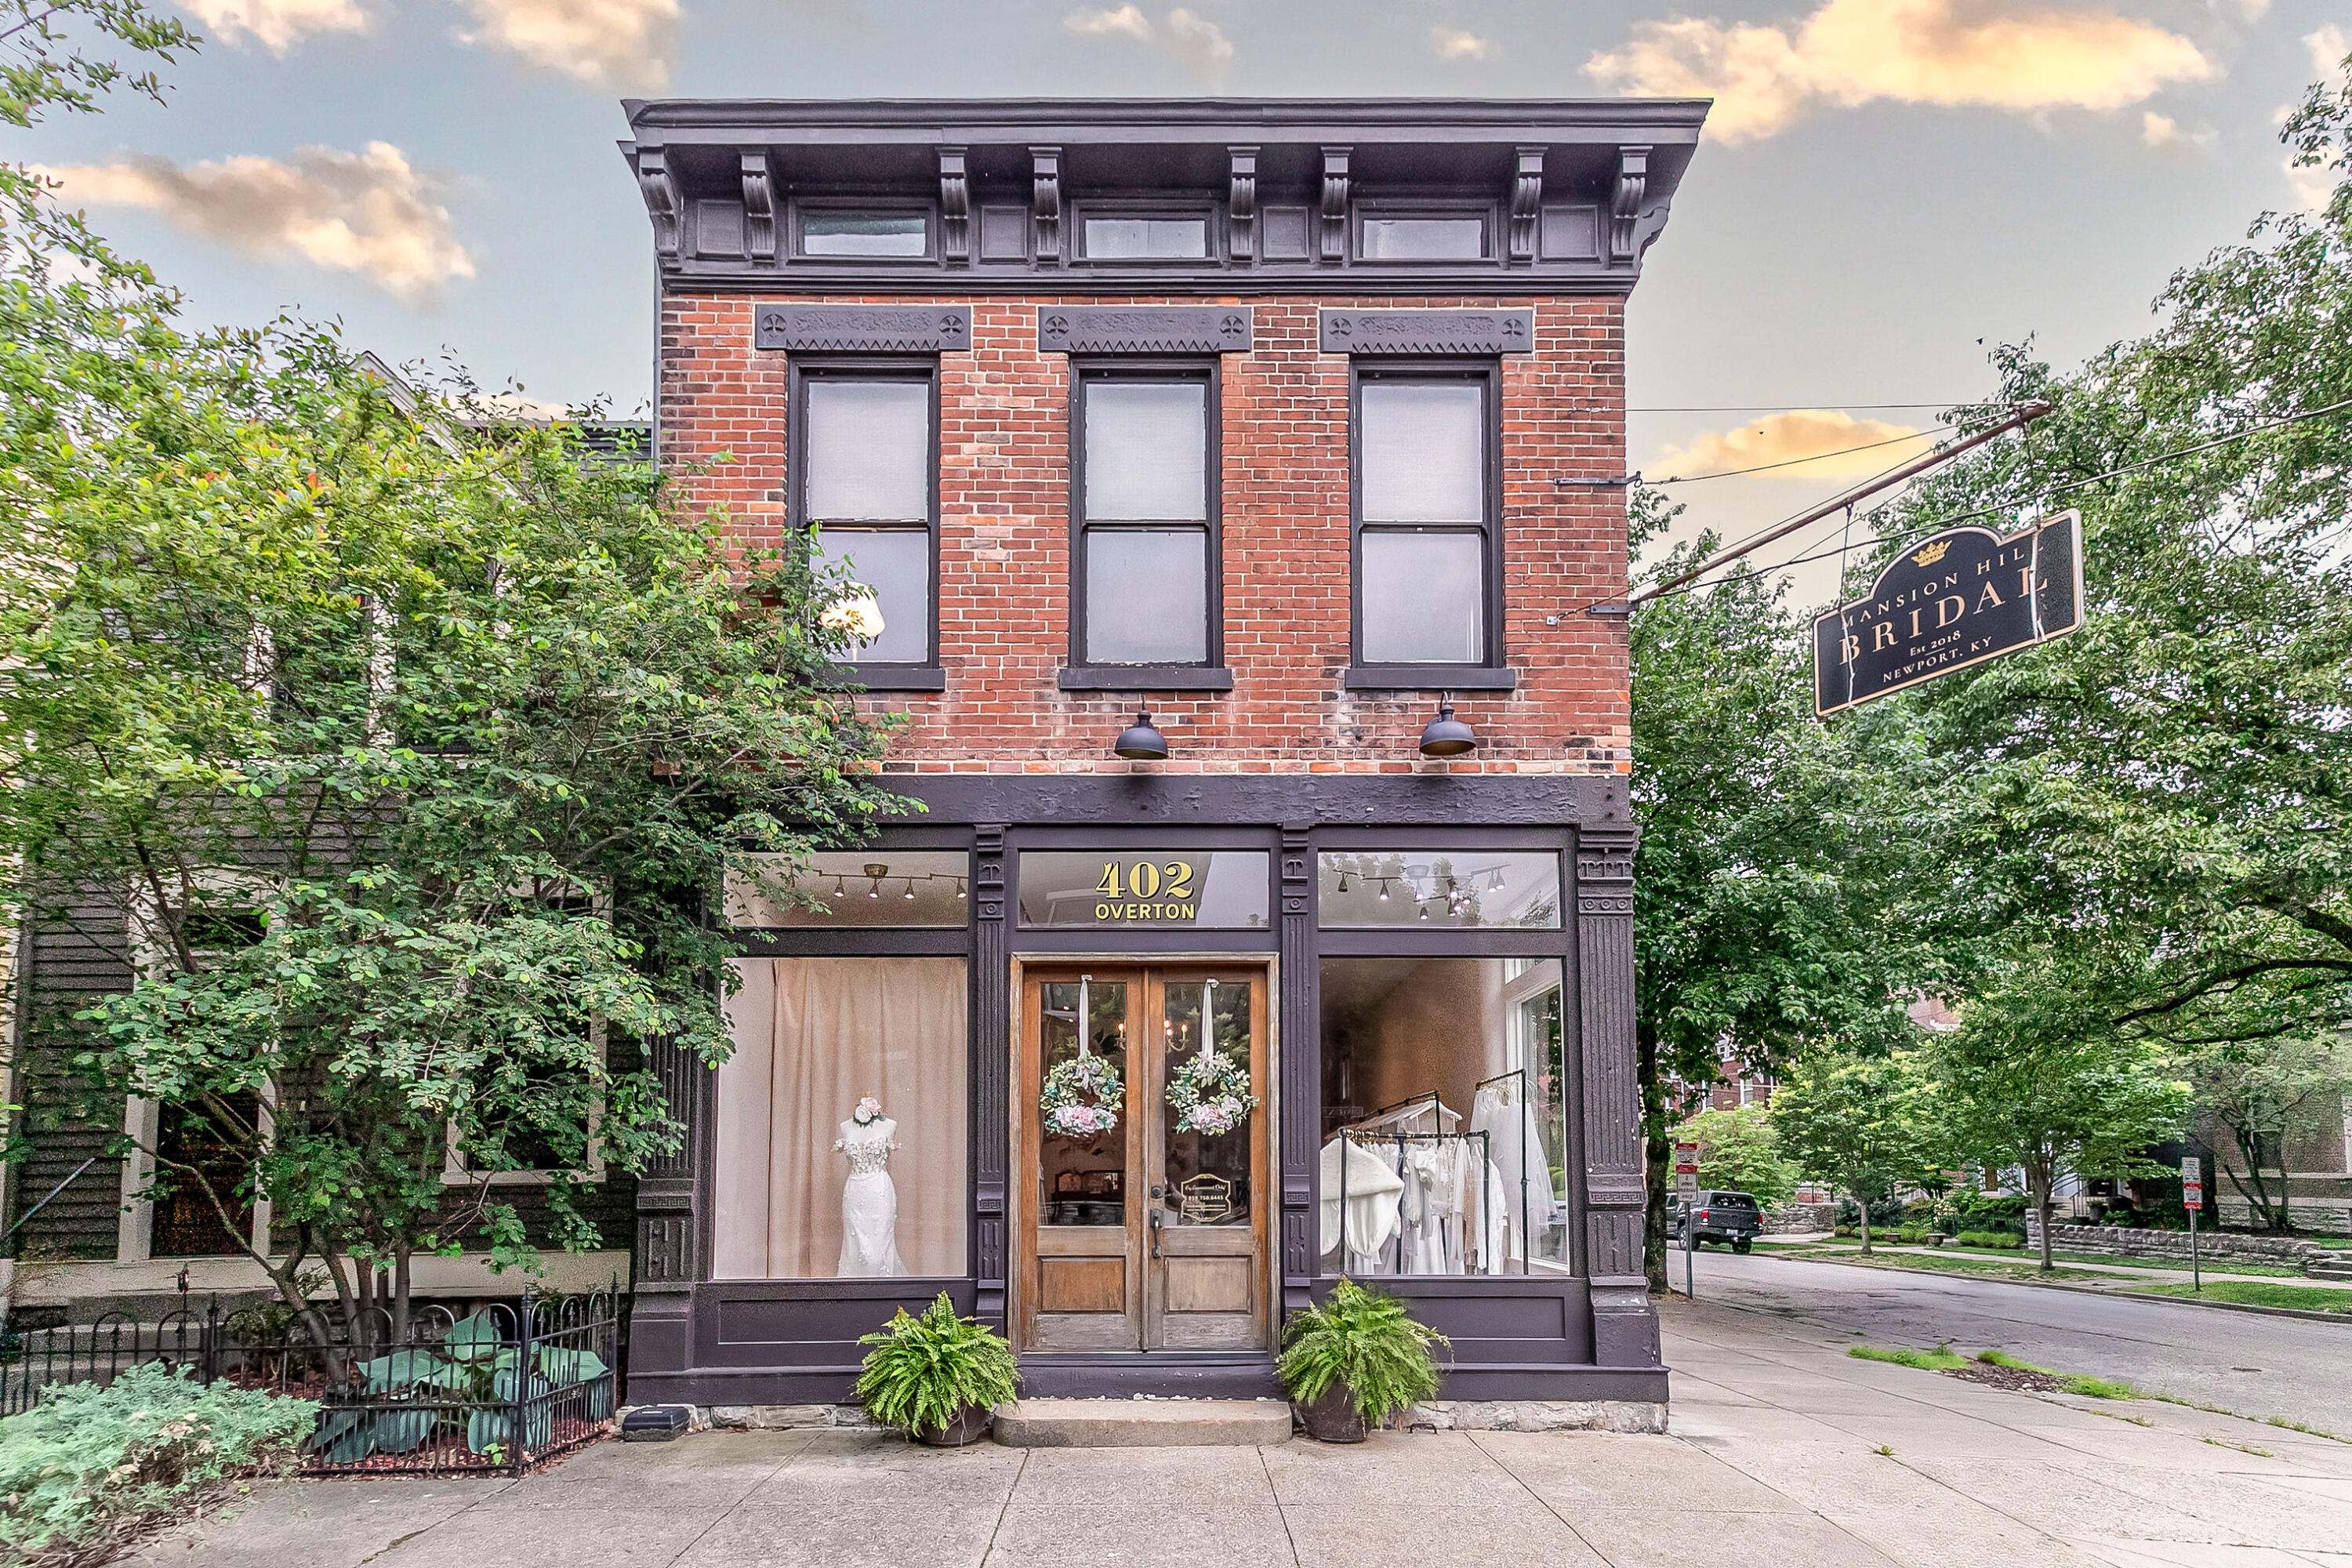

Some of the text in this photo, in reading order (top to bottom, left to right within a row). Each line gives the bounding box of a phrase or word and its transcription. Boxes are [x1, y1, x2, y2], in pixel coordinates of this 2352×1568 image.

[1842, 546, 2044, 630] MANSION HIL
[1838, 566, 2048, 665] BRIDAL
[1910, 630, 1962, 657] Est 2018
[1971, 636, 1992, 652] KY
[1095, 861, 1194, 899] 402
[1094, 903, 1196, 920] OVERTON
